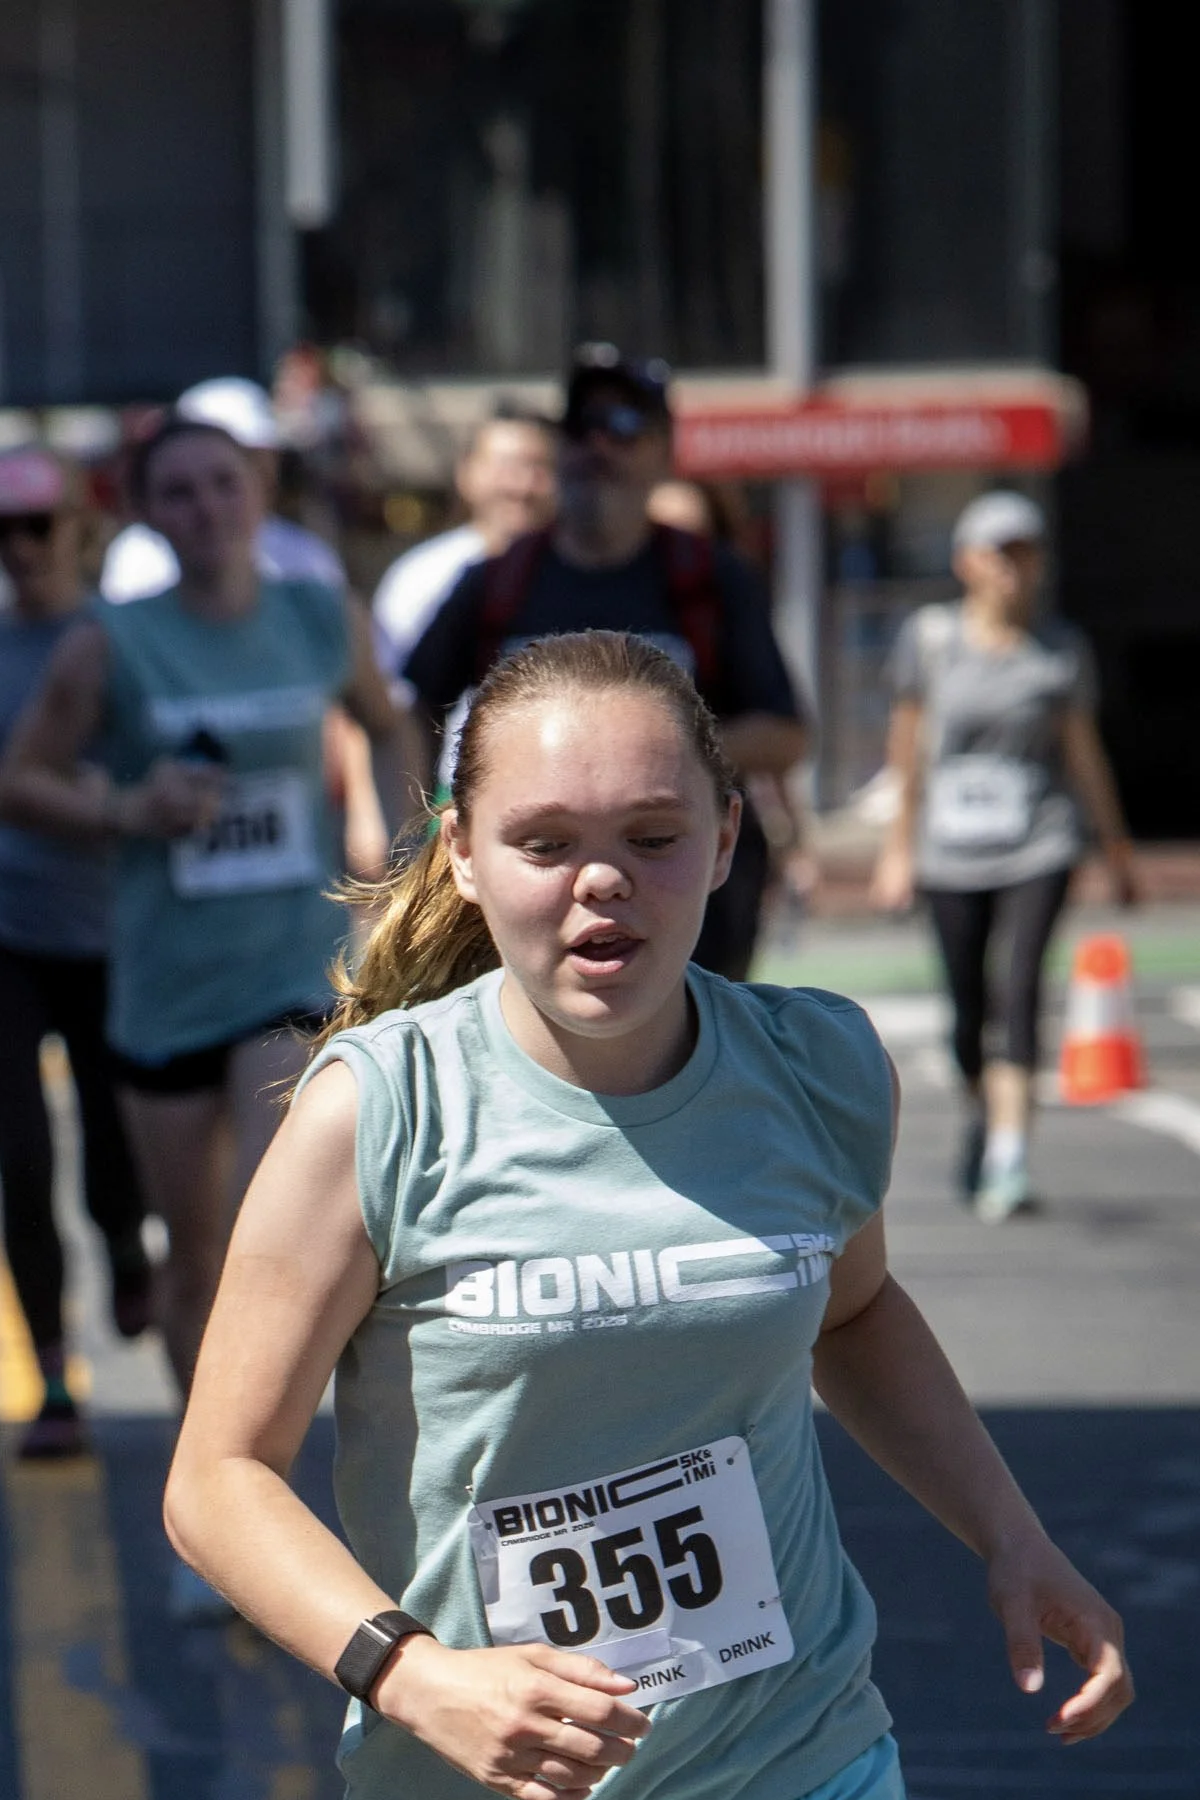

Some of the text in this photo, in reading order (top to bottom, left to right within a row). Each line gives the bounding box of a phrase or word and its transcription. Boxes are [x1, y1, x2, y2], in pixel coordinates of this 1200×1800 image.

[445, 1234, 798, 1317] BIONIC
[448, 1319, 541, 1335] CAMBRIDGE
[492, 1459, 684, 1537] BIONIC
[501, 1532, 551, 1547] CAMBRIDGE
[529, 1505, 723, 1647] 355
[719, 1632, 776, 1663] DRINK
